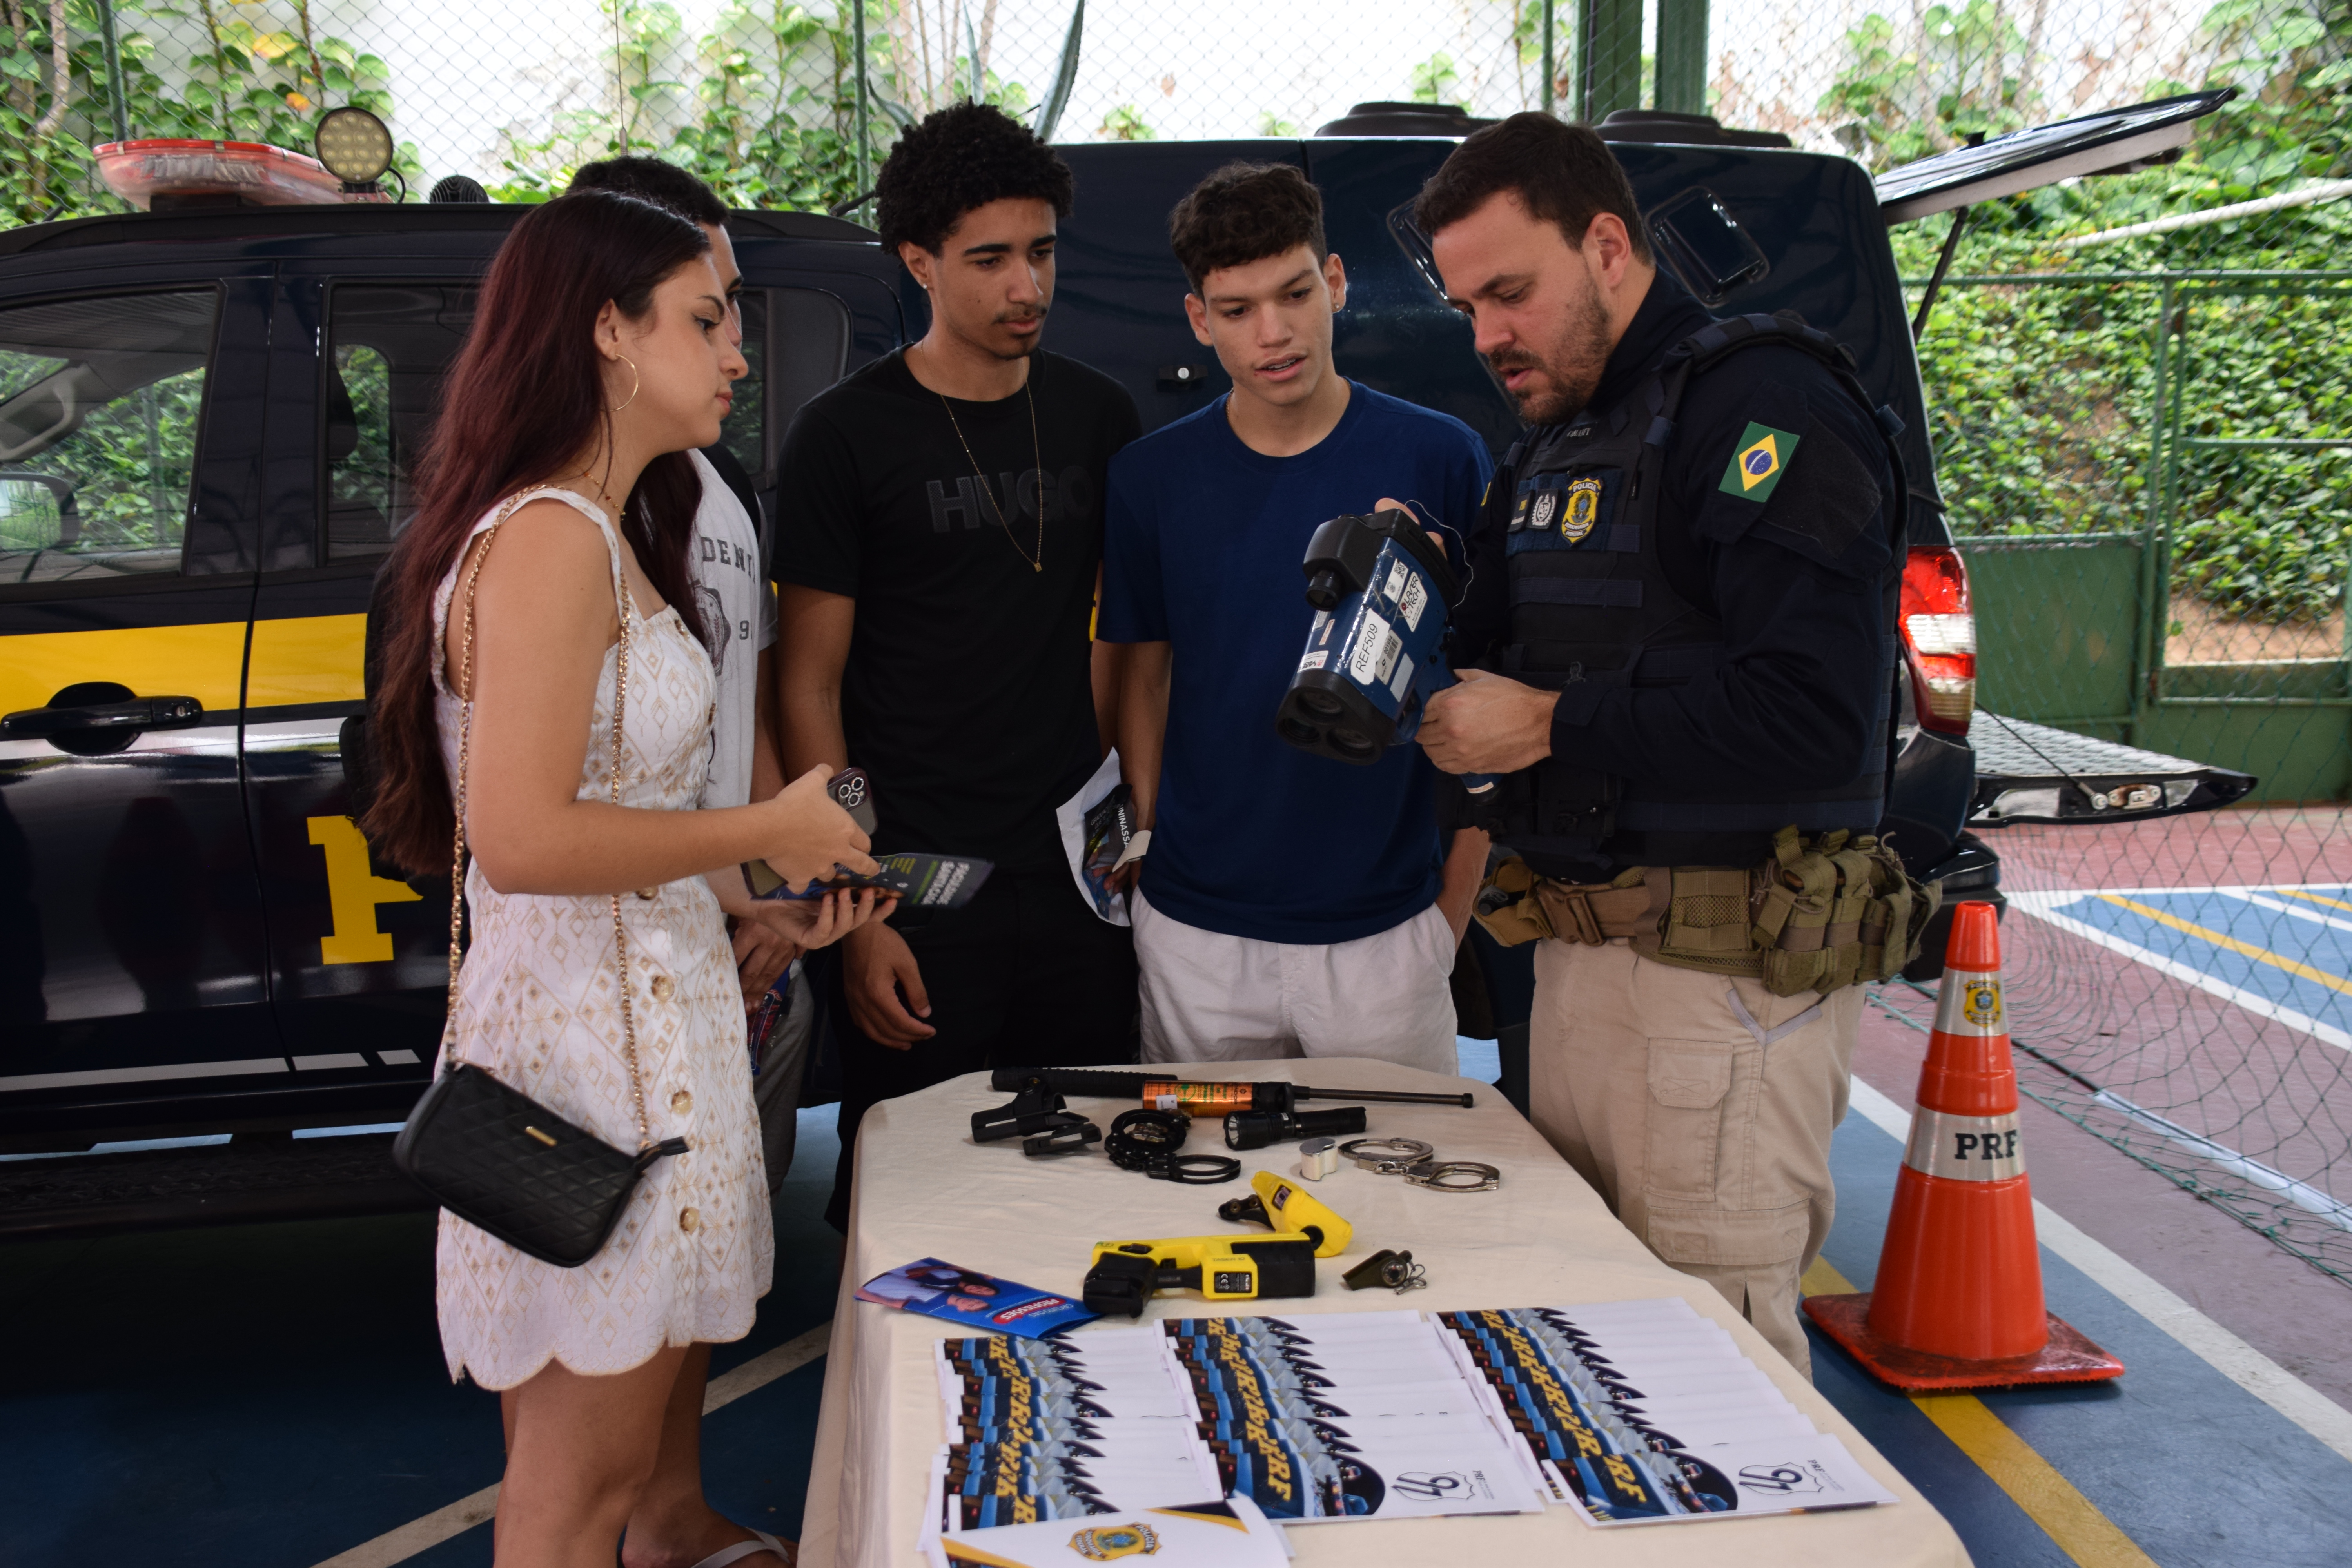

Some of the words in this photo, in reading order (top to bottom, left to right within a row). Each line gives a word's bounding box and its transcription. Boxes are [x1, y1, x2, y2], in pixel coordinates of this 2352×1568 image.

[926, 465, 1094, 533] HUGO
[701, 537, 756, 584] DENI
[1404, 576, 1418, 604] LASER
[1408, 588, 1421, 612] TECH
[1356, 623, 1377, 673] REF509
[1955, 1129, 2018, 1160] PRF
[1000, 1298, 1060, 1319] PROFISSÕES
[1472, 1470, 1485, 1484] PRF
[1808, 1459, 1823, 1473] PRF
